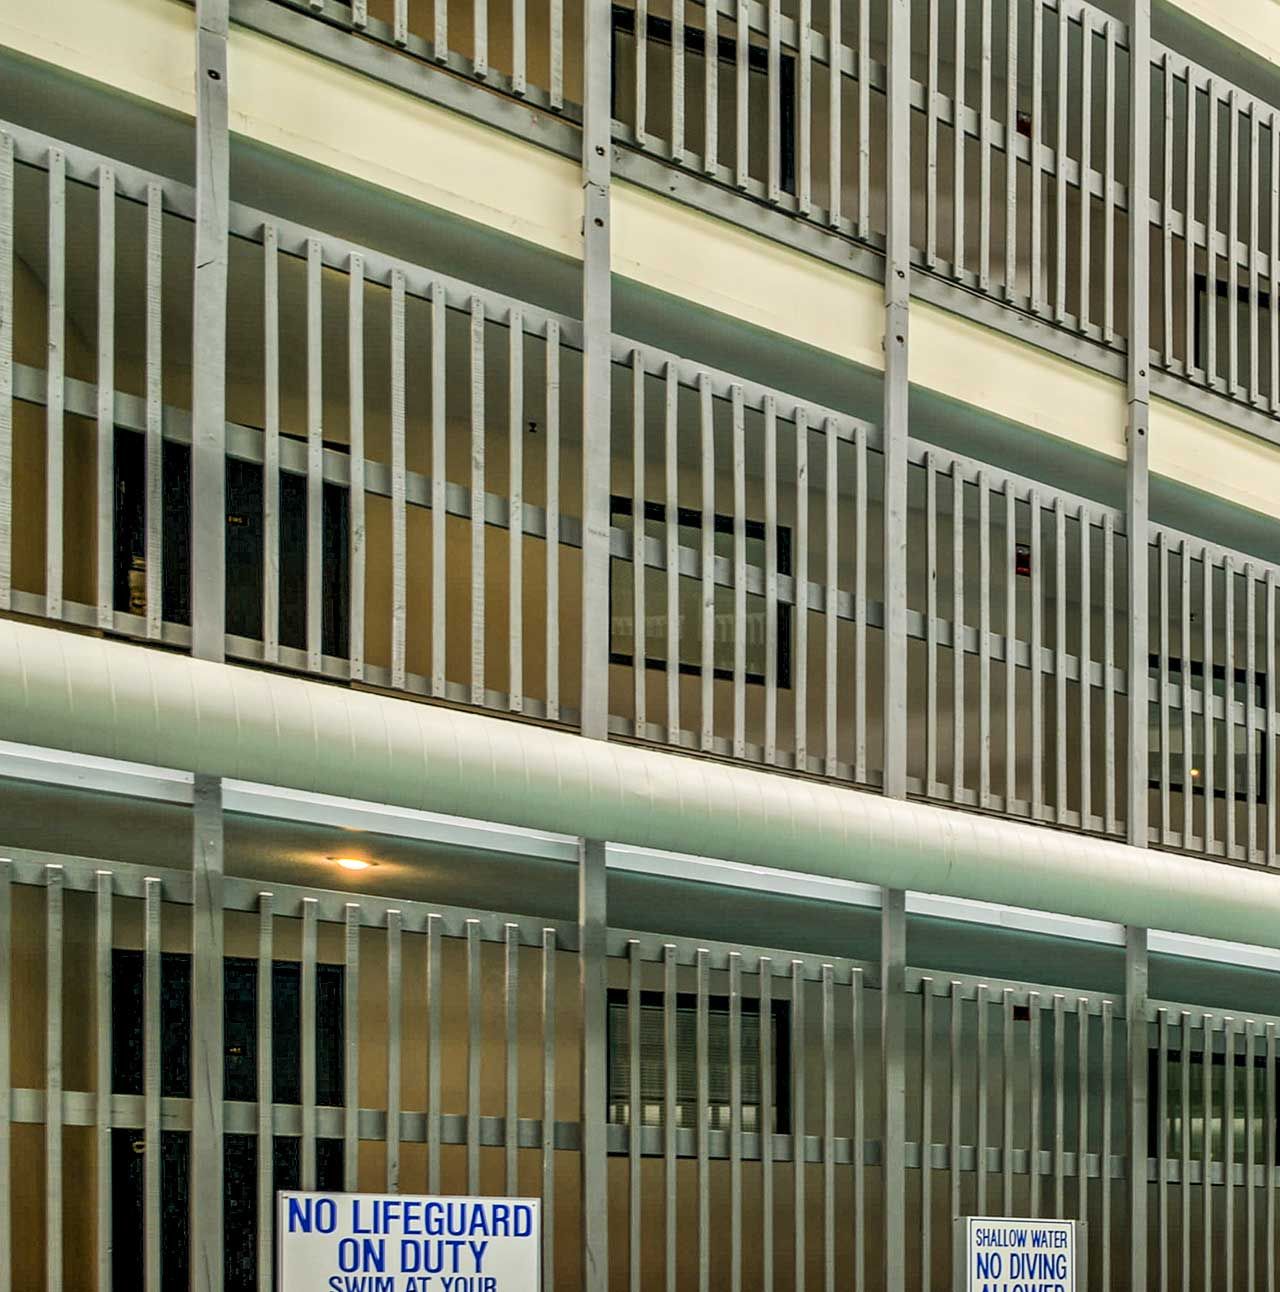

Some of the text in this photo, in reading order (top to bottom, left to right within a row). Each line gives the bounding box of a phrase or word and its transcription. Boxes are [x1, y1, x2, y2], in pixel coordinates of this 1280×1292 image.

[288, 1198, 533, 1237] NO LIFEGUARD
[976, 1228, 1068, 1248] SHALLOW WATER
[338, 1238, 489, 1273] ON DUTY
[977, 1252, 1067, 1280] NO DIVING
